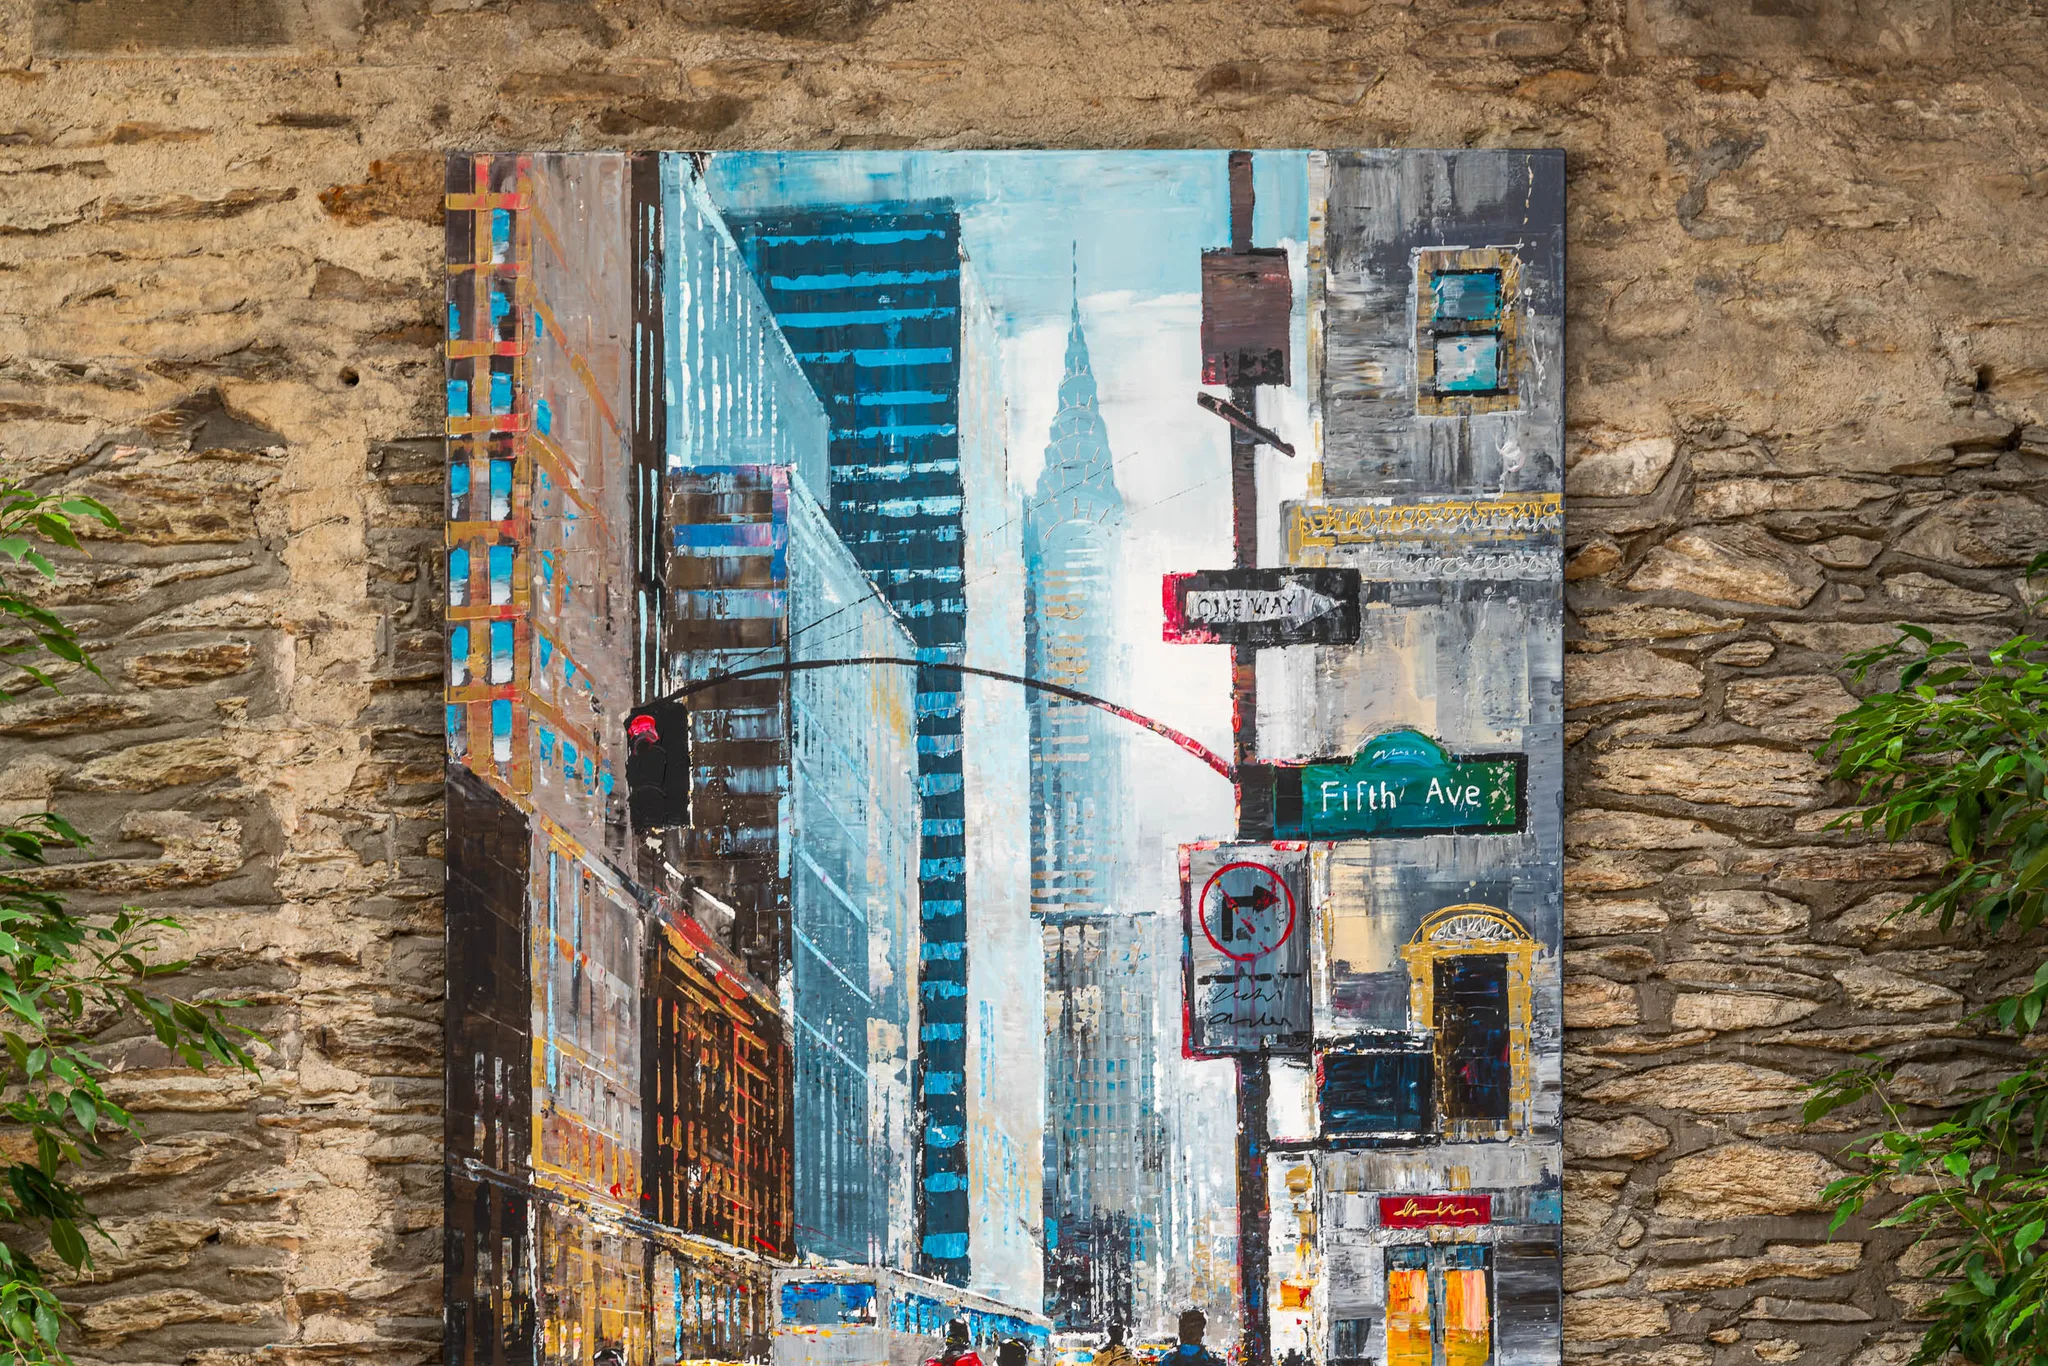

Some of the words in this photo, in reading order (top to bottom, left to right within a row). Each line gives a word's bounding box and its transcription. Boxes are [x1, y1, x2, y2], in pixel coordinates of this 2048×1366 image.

[1198, 598, 1242, 617] ONE
[1248, 595, 1296, 615] WAY
[1320, 780, 1397, 811] Fifth
[1425, 777, 1481, 806] Ave
